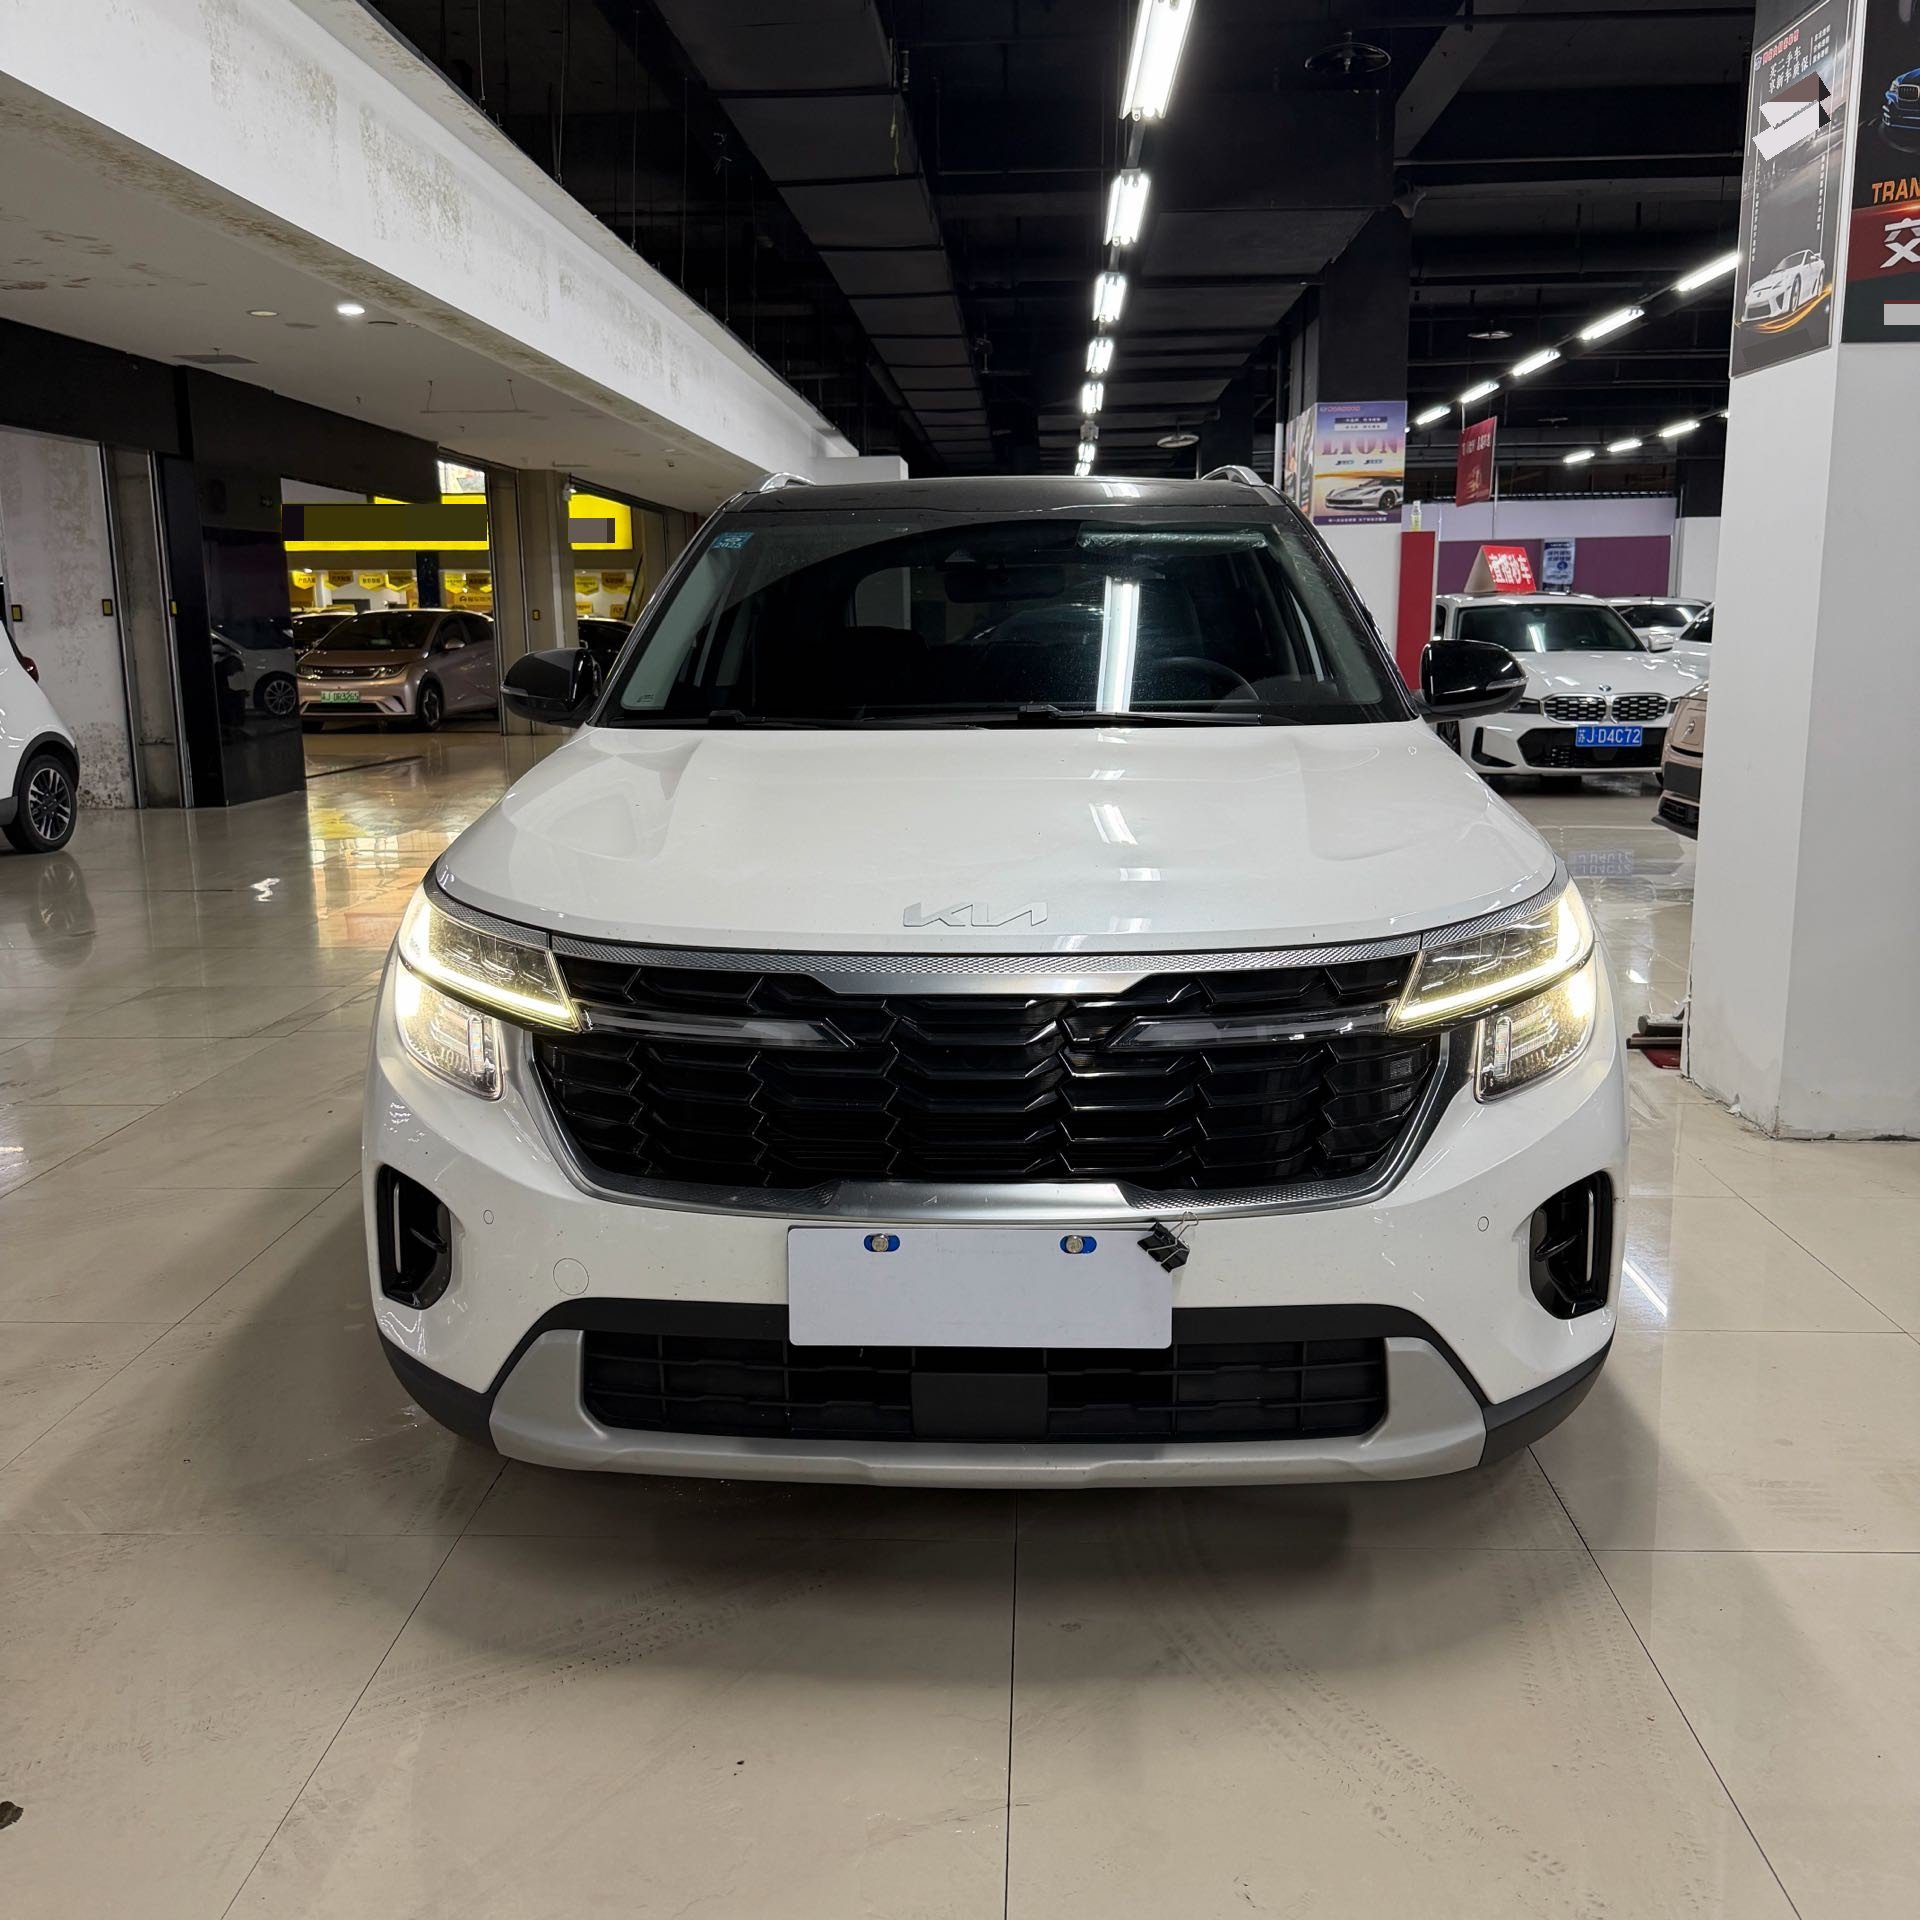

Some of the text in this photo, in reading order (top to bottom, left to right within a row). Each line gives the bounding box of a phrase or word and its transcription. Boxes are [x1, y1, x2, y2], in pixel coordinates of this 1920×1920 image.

[1769, 46, 1802, 81] 买二手车
[1880, 218, 1920, 269] 交
[1321, 437, 1398, 456] LION
[903, 902, 1049, 928] KIA
